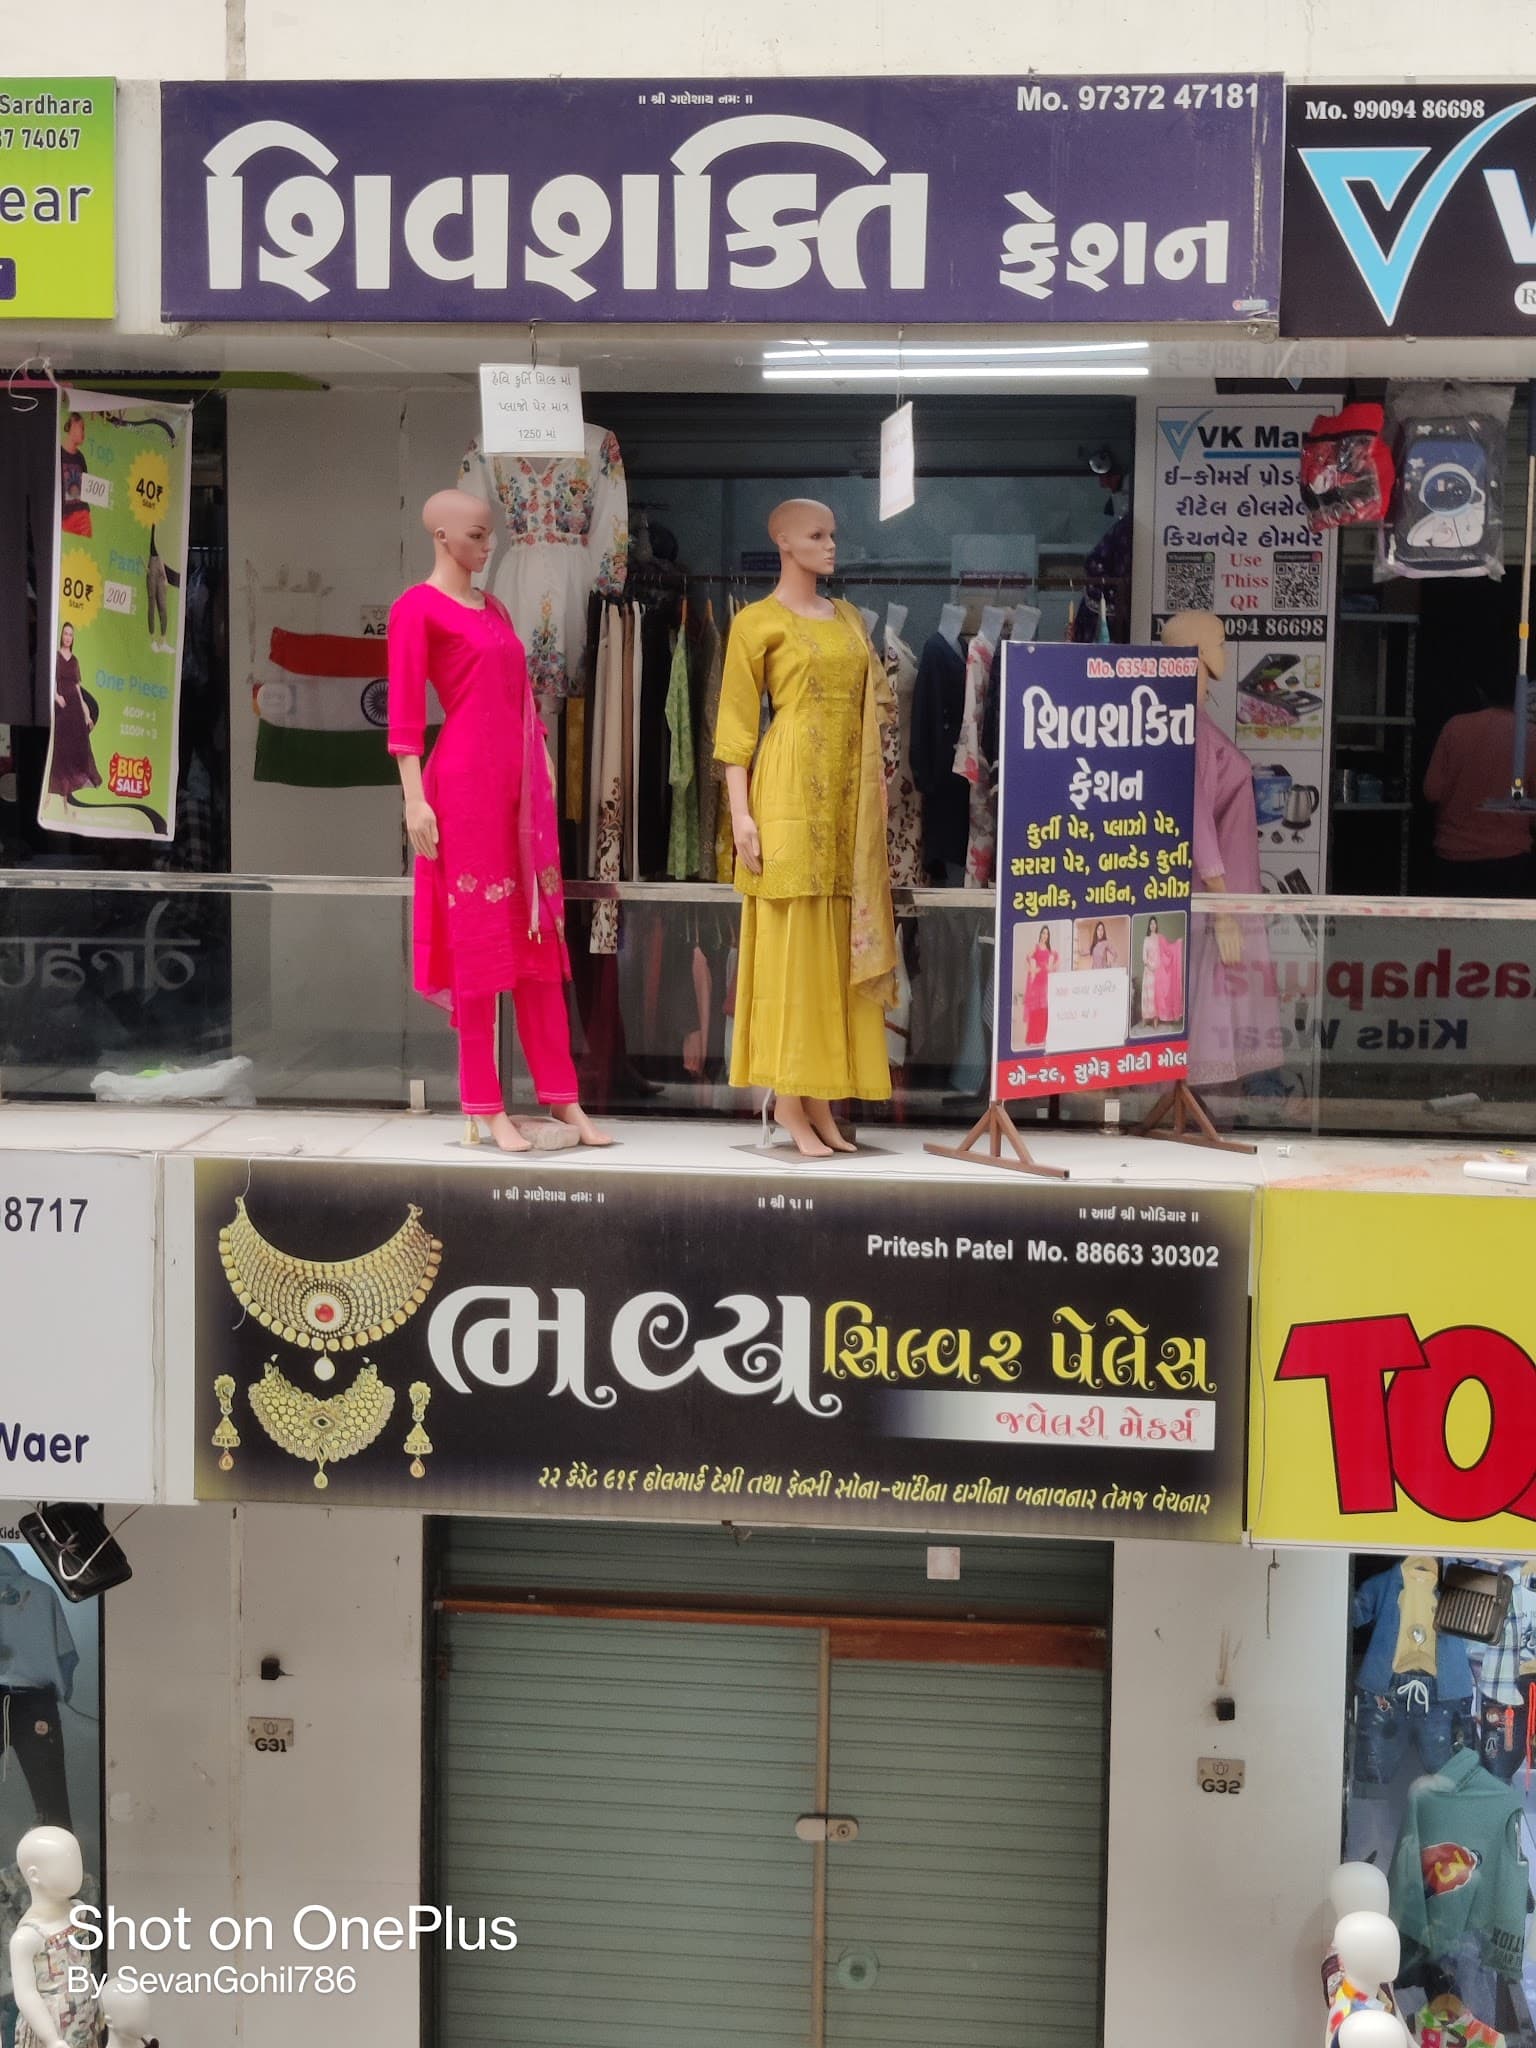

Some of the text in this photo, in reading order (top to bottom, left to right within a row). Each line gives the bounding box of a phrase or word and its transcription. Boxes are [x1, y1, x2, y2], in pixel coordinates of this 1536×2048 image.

[0, 94, 94, 115] Sardhara
[651, 92, 665, 105] શ્રી
[670, 91, 713, 105] ગણેશાય
[1017, 83, 1259, 111] Mo. 97372 47181
[1305, 99, 1485, 120] Mo. 99094 86698
[21, 128, 81, 149] 74067
[999, 191, 1230, 300] ફેશન
[518, 429, 541, 440] 1250
[1198, 427, 1243, 448] VK
[86, 480, 106, 497] 300
[1229, 553, 1262, 567] Use
[1222, 574, 1269, 588] Thiss
[106, 587, 127, 604] 200
[1230, 595, 1258, 610] QR
[1265, 618, 1324, 636] 86698
[1087, 657, 1198, 677] Mo. 63542 50667
[96, 670, 168, 699] One Piece
[117, 757, 145, 779] BIG
[116, 777, 143, 794] SALE
[1069, 757, 1143, 810] ફેશન
[867, 1234, 1219, 1267] Pritesh Patel Mo. 88663 30302
[255, 1738, 287, 1752] G31
[1202, 1778, 1241, 1794] G32
